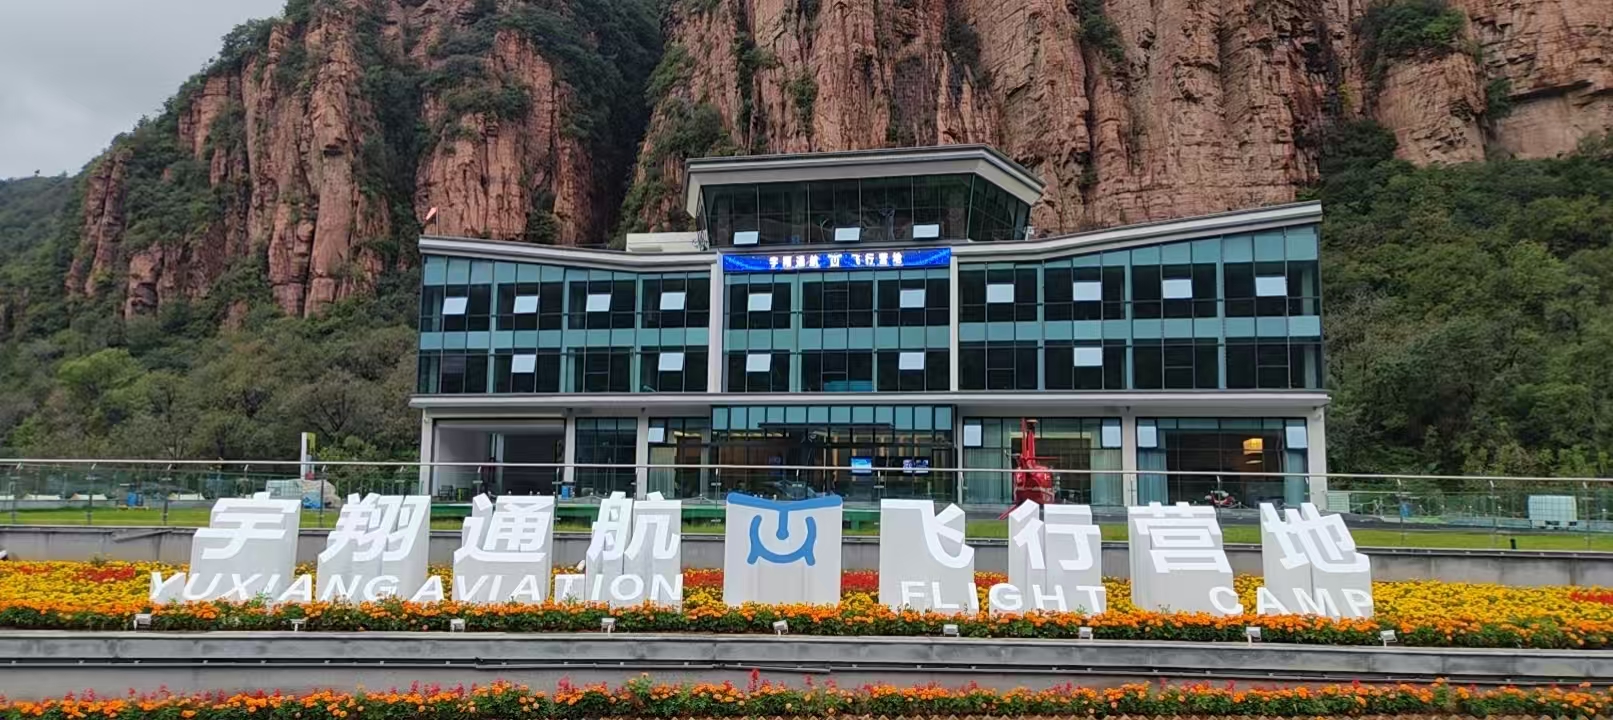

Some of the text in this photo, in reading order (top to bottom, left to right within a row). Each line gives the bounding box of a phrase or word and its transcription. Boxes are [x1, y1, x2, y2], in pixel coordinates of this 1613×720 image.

[195, 492, 1371, 574] 宇翔通航 飞行营地
[150, 571, 1374, 617] YUXIANG AVIATION FLIGHT CAMP
